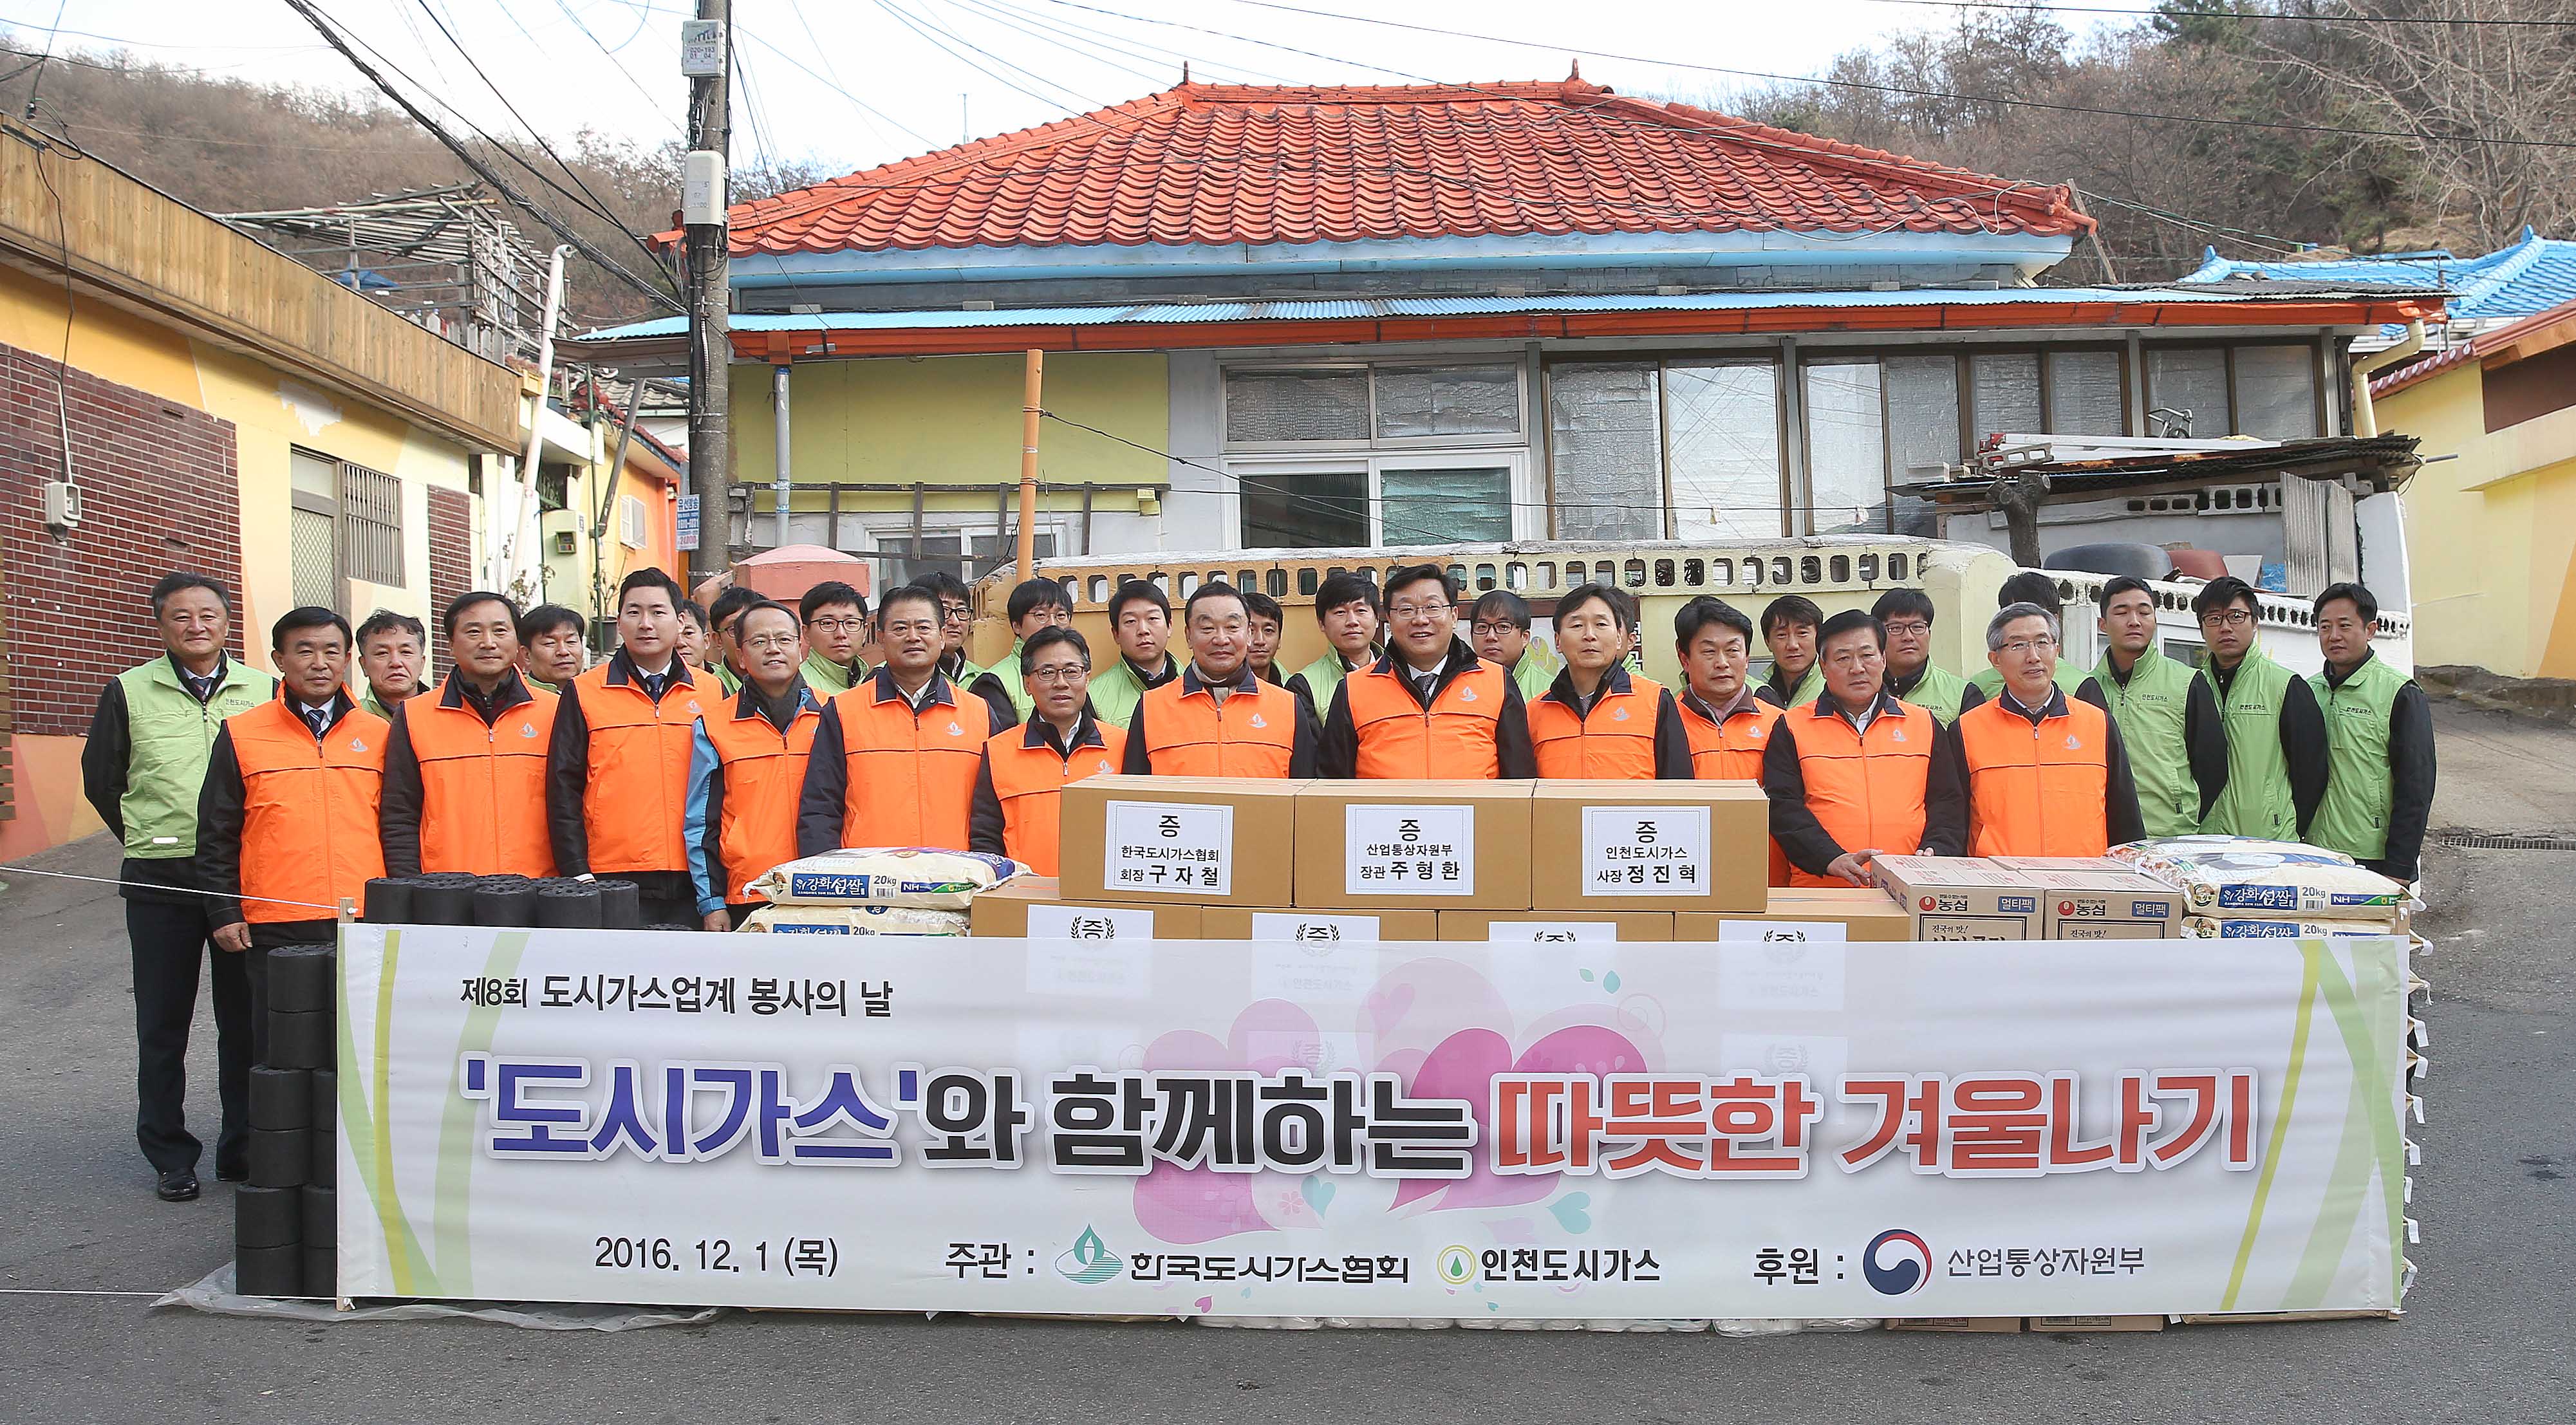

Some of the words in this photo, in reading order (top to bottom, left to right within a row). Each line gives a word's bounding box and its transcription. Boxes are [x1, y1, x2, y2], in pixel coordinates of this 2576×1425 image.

[225, 698, 255, 707] 인천도시가스
[1159, 815, 1181, 837] 증
[1399, 819, 1421, 841] 증
[1636, 821, 1657, 843] 증
[1121, 845, 1218, 862] 한국도시가스협회
[1367, 844, 1453, 856] 산업통상자원부
[1606, 846, 1688, 859] 인천도시가스
[1120, 869, 1144, 881] 회장
[1360, 866, 1385, 879] 장관
[1597, 870, 1622, 882] 사장
[807, 876, 863, 895] 강화섬쌀
[873, 875, 897, 886] 20kg
[1938, 899, 1968, 911] 농심
[2002, 899, 2032, 910] 멀티팩
[2234, 887, 2292, 907] 강화섬쌀
[2302, 887, 2326, 898] 20kg
[2077, 904, 2105, 916] 농심
[2136, 904, 2166, 915] 멀티팩
[1081, 920, 1104, 940] 증
[1956, 925, 1968, 933] 맛!
[2094, 930, 2106, 938] 맛!
[2304, 925, 2327, 936] 20kg
[460, 978, 527, 1008] 제8회
[540, 974, 735, 1014] 도시가스업계
[747, 978, 846, 1017] 봉사의
[861, 981, 893, 1018] 날
[467, 1059, 1025, 1160] '도시가스'와
[1052, 1074, 1470, 1171] 함께하는
[1499, 1077, 1814, 1171] 따뜻한
[1843, 1075, 2248, 1169] 겨울나기
[595, 1237, 679, 1272] 2016.
[696, 1240, 739, 1272] 12.
[783, 1238, 838, 1277] (목)
[946, 1243, 1012, 1279] 주관
[1481, 1249, 1660, 1281] 인천도시가스
[1948, 1247, 2145, 1278] 산업통상자원부
[1131, 1251, 1408, 1283] 한국도시가스협회
[1753, 1248, 1818, 1285] 후원
